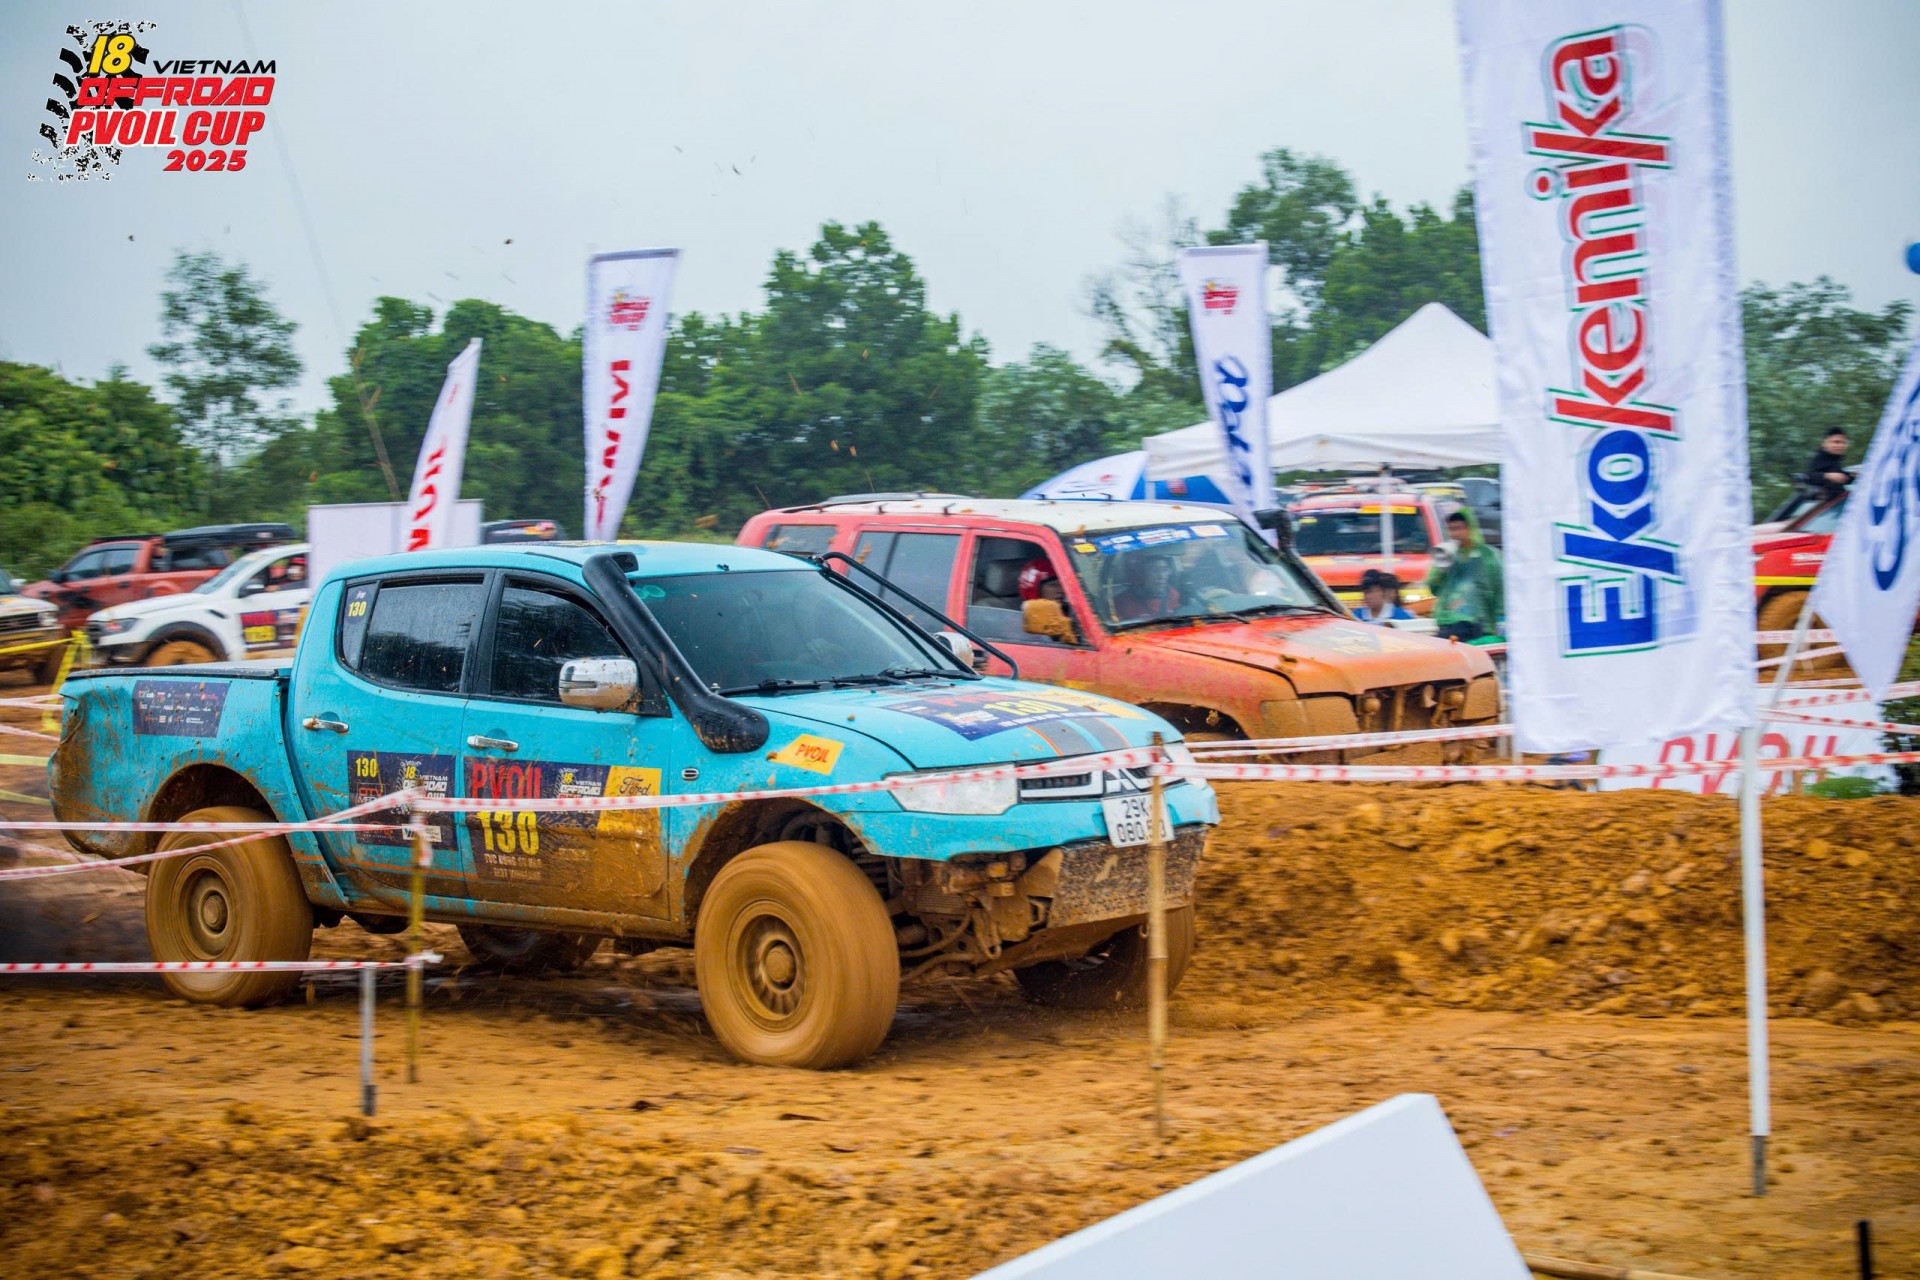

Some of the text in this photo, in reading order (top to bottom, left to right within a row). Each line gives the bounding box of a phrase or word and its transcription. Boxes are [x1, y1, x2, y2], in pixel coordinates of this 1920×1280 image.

[1522, 24, 1684, 657] Ekokemika
[348, 601, 367, 616] 130
[982, 700, 1069, 716] 130
[795, 743, 829, 763] PVOIL
[355, 757, 378, 777] 130
[405, 766, 417, 779] 18
[403, 780, 448, 792] OFROAD
[619, 777, 652, 796] Ford
[477, 811, 540, 855] 130
